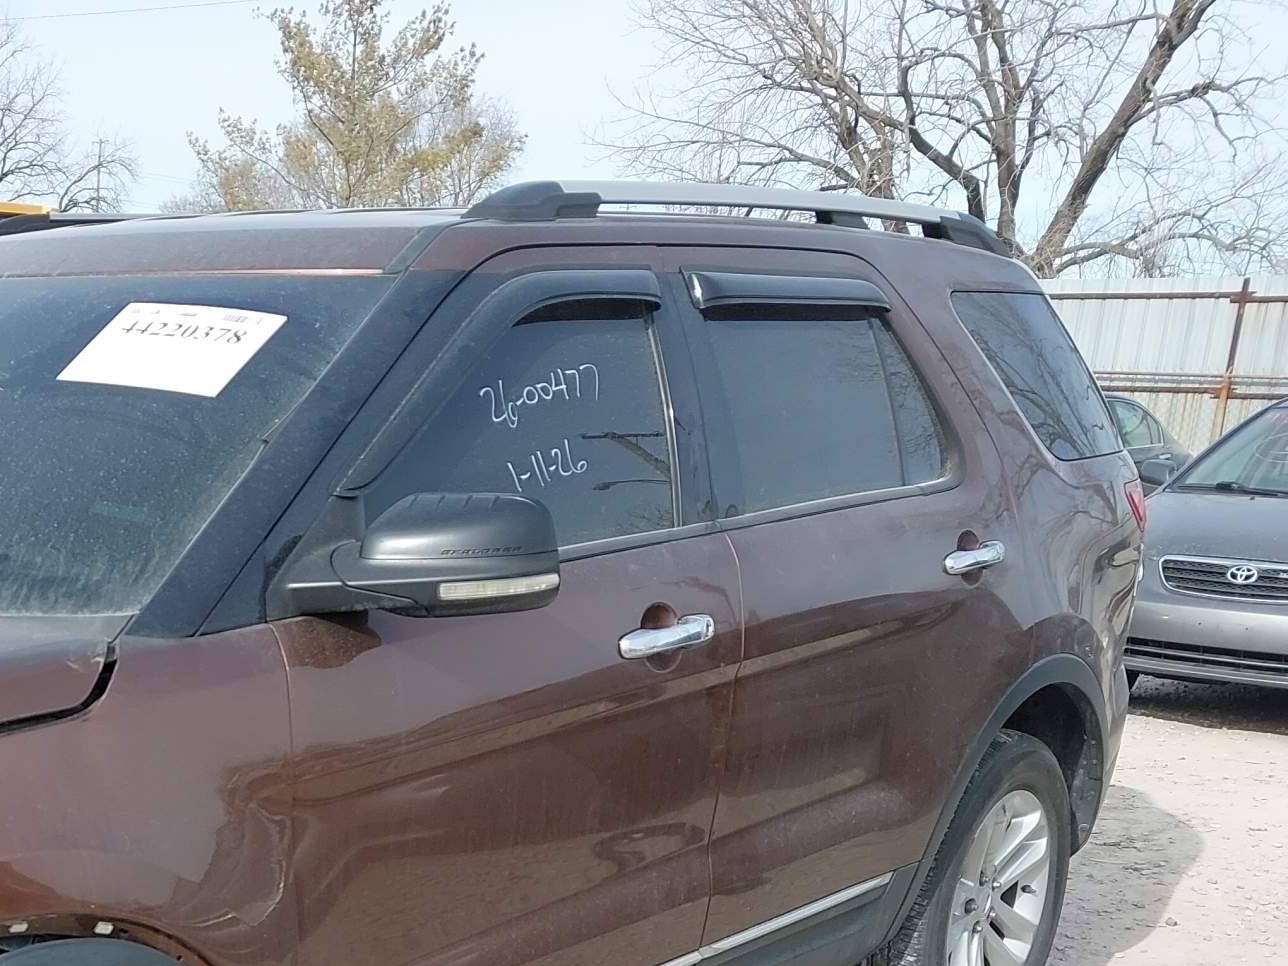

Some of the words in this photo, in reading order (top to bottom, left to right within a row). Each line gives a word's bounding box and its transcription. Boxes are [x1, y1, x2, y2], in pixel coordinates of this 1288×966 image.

[121, 319, 248, 345] 44220378
[479, 363, 599, 428] 26-00477
[506, 439, 588, 493] 1-11-26
